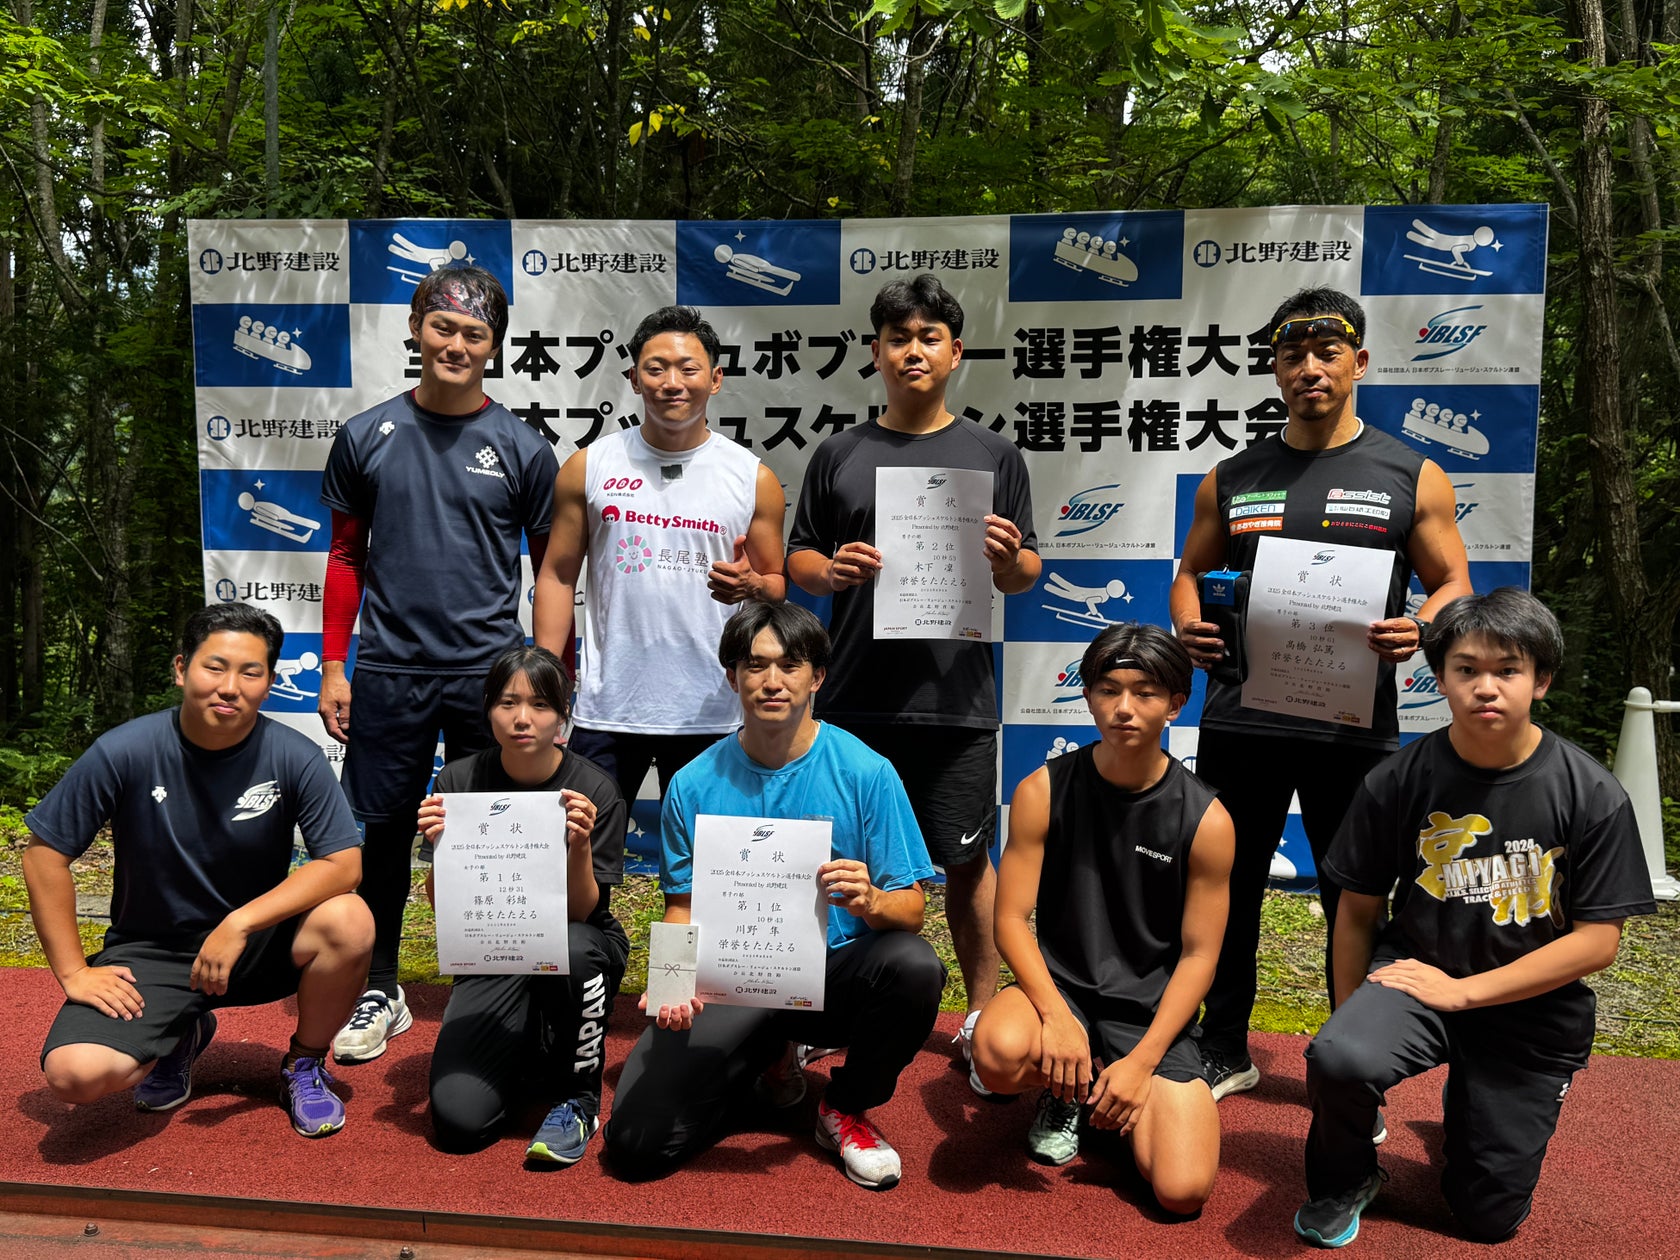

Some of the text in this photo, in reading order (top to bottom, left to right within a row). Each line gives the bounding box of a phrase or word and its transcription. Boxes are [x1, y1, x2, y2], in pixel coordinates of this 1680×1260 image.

[226, 251, 340, 272] 北野建設
[551, 252, 667, 273] 北野建設
[880, 248, 1000, 271] 北野建設
[1225, 240, 1352, 264] 北野建設
[1415, 325, 1488, 344] JBLSF
[234, 418, 343, 440] 北野建設
[1058, 503, 1125, 520] JBLSF
[658, 548, 709, 568] 長尾塾
[915, 562, 933, 573] 木下
[240, 581, 323, 602] 北野建
[1504, 838, 1535, 853] 2024
[1442, 852, 1541, 888] MIYAGI
[735, 925, 757, 936] 川野
[574, 973, 606, 1073] JAPAN
